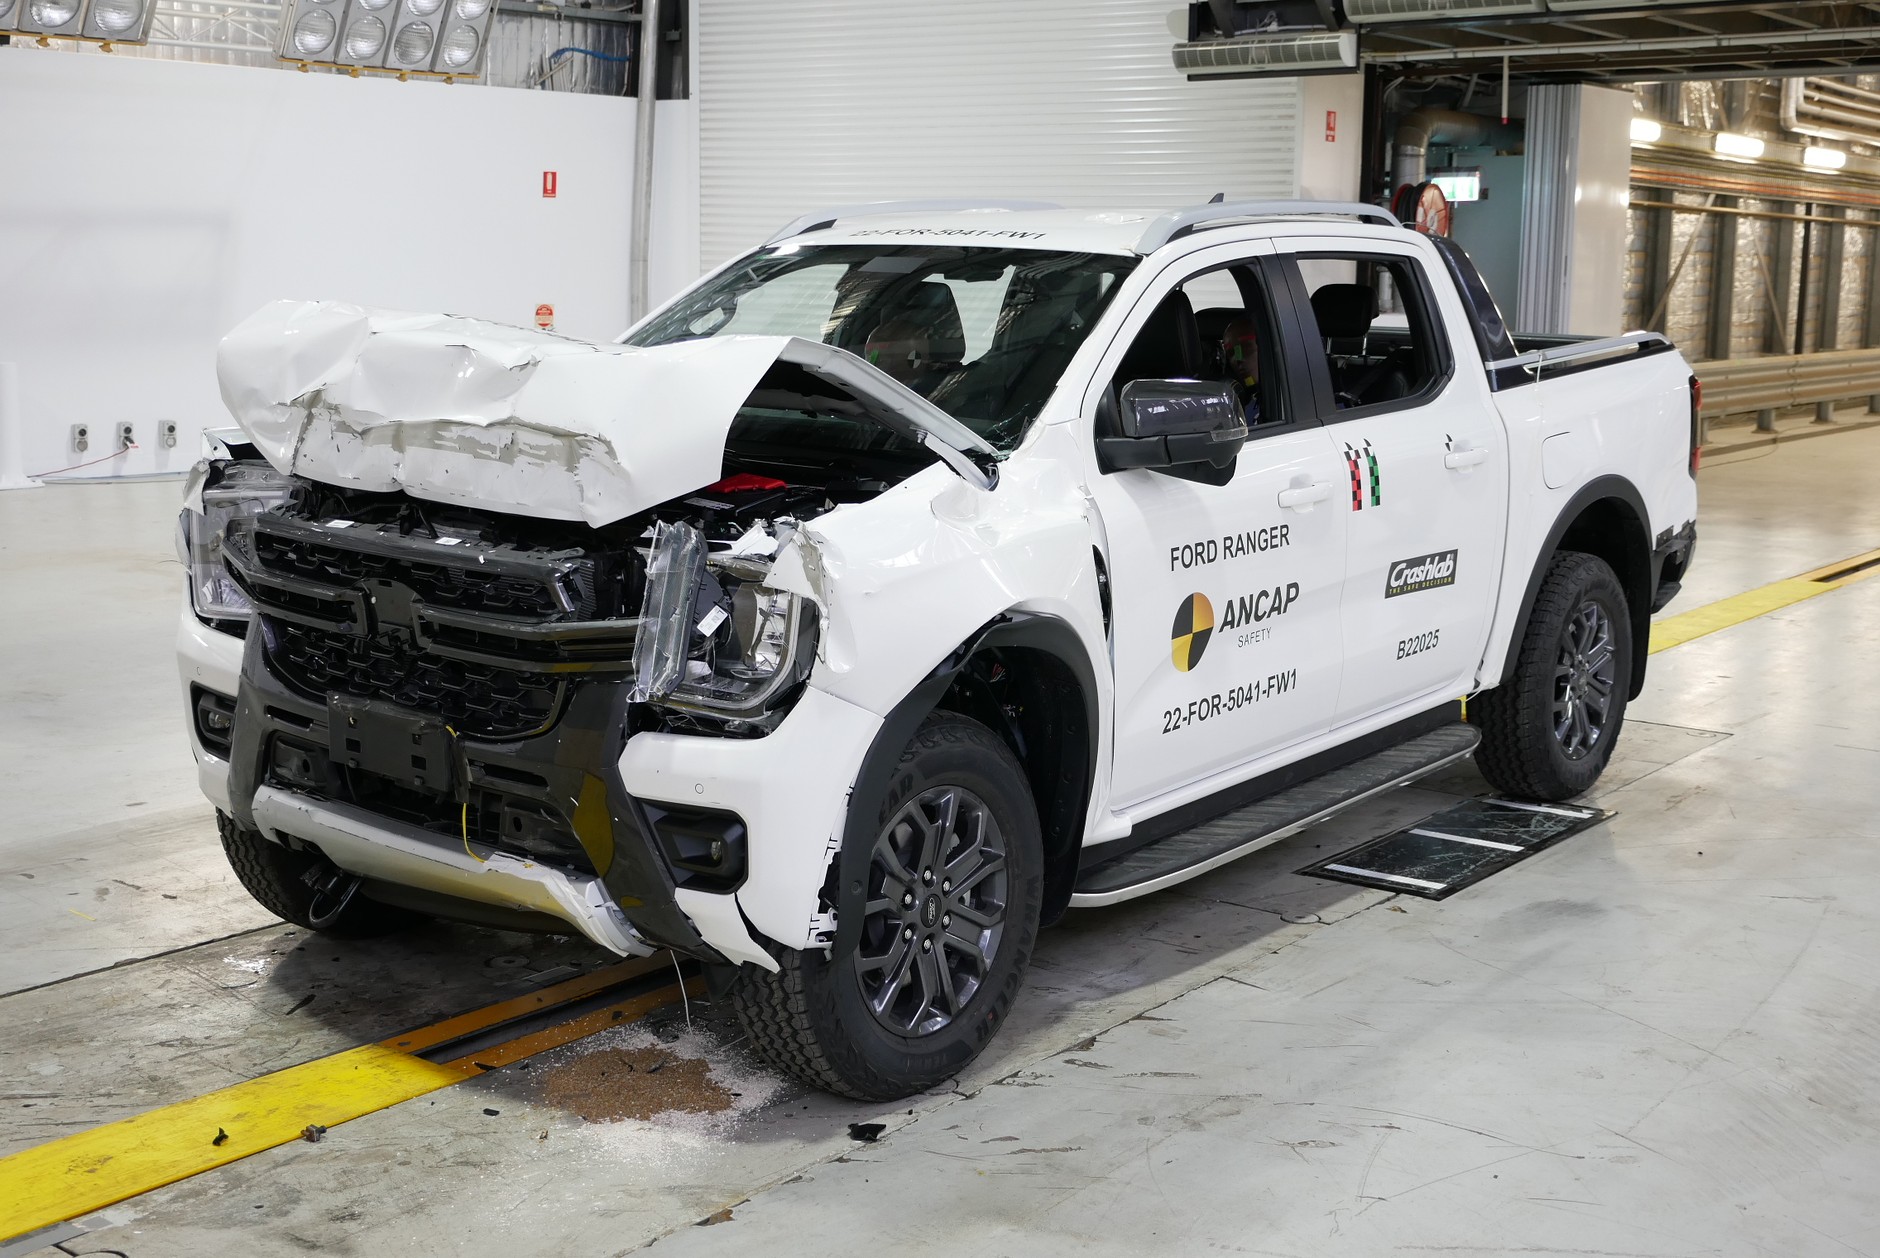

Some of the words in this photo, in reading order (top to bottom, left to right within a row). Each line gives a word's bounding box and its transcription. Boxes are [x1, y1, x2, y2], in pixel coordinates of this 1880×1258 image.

[848, 228, 1046, 240] 22-FOR-5041-FW1
[1170, 539, 1217, 571] FORD
[1223, 524, 1290, 560] RANGER
[1390, 553, 1454, 588] Crashlab
[1218, 581, 1300, 633] ANCAP
[1237, 626, 1272, 648] SAFETY
[1396, 628, 1440, 660] B22025
[1162, 668, 1296, 734] 22-FOR-5041-FW1
